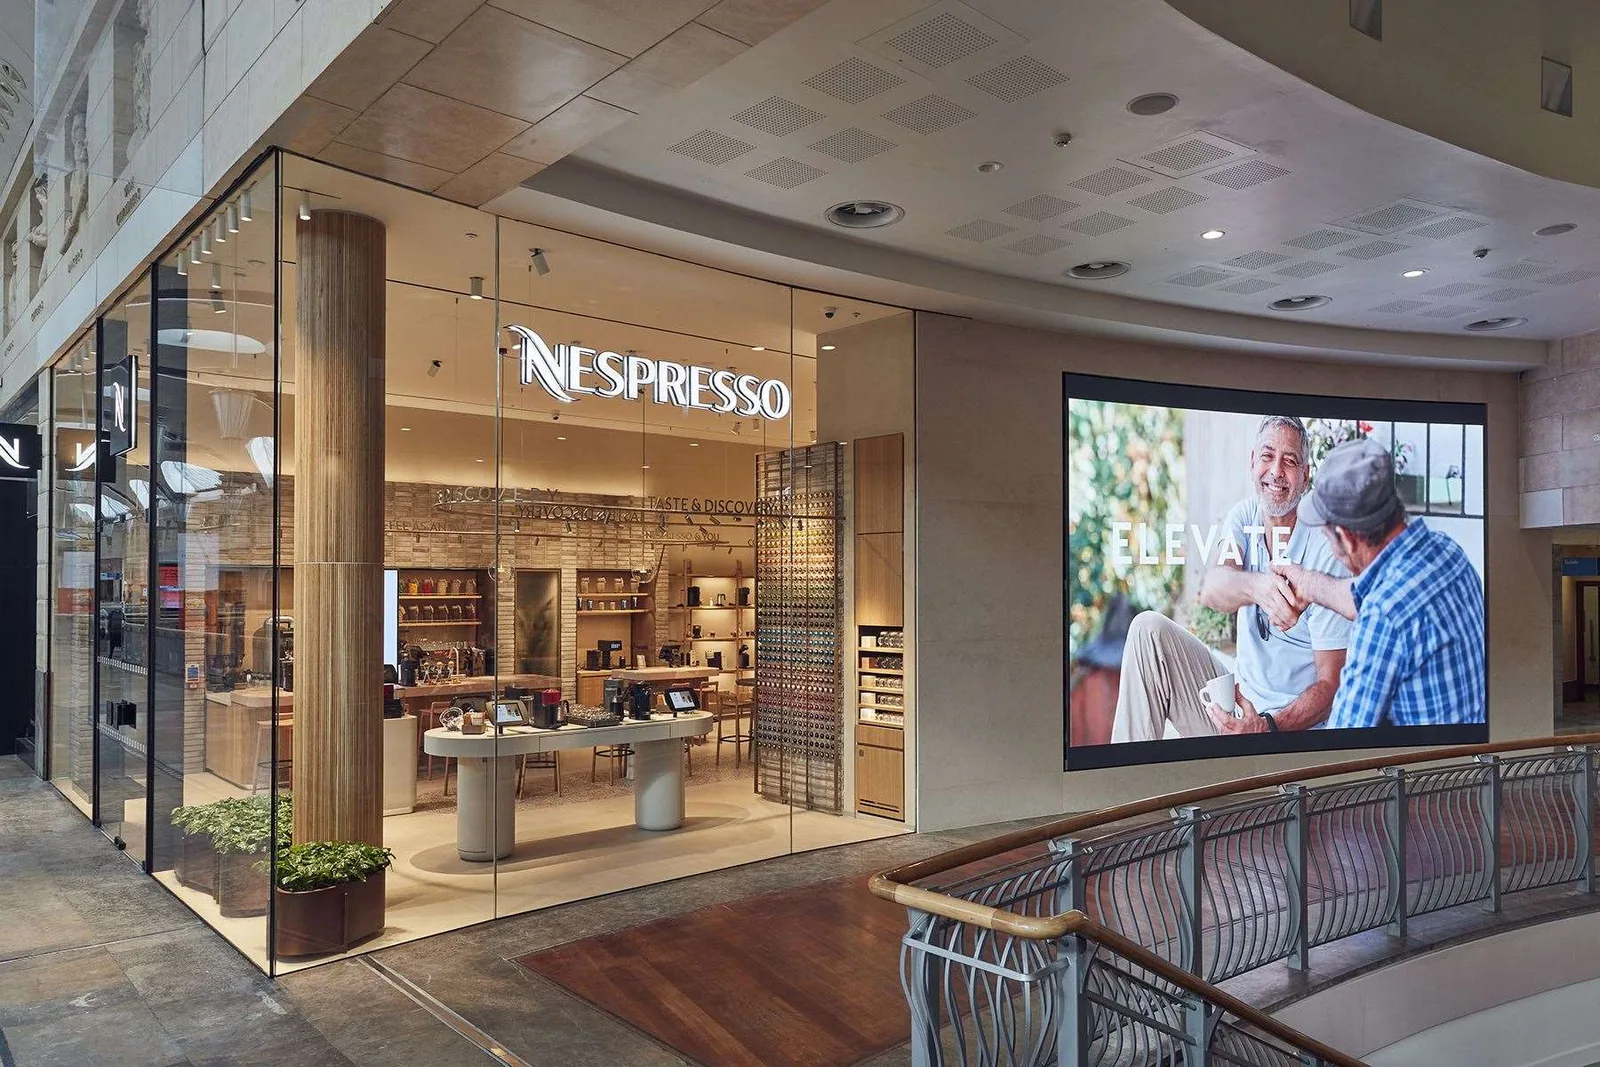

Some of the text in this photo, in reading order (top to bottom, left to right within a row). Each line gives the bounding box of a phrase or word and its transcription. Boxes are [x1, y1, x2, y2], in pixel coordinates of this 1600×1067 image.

[503, 324, 790, 420] NESPRESSO
[113, 381, 126, 432] N
[647, 495, 689, 511] TASTE
[691, 498, 701, 512] &
[1112, 521, 1293, 567] ELEVATE
